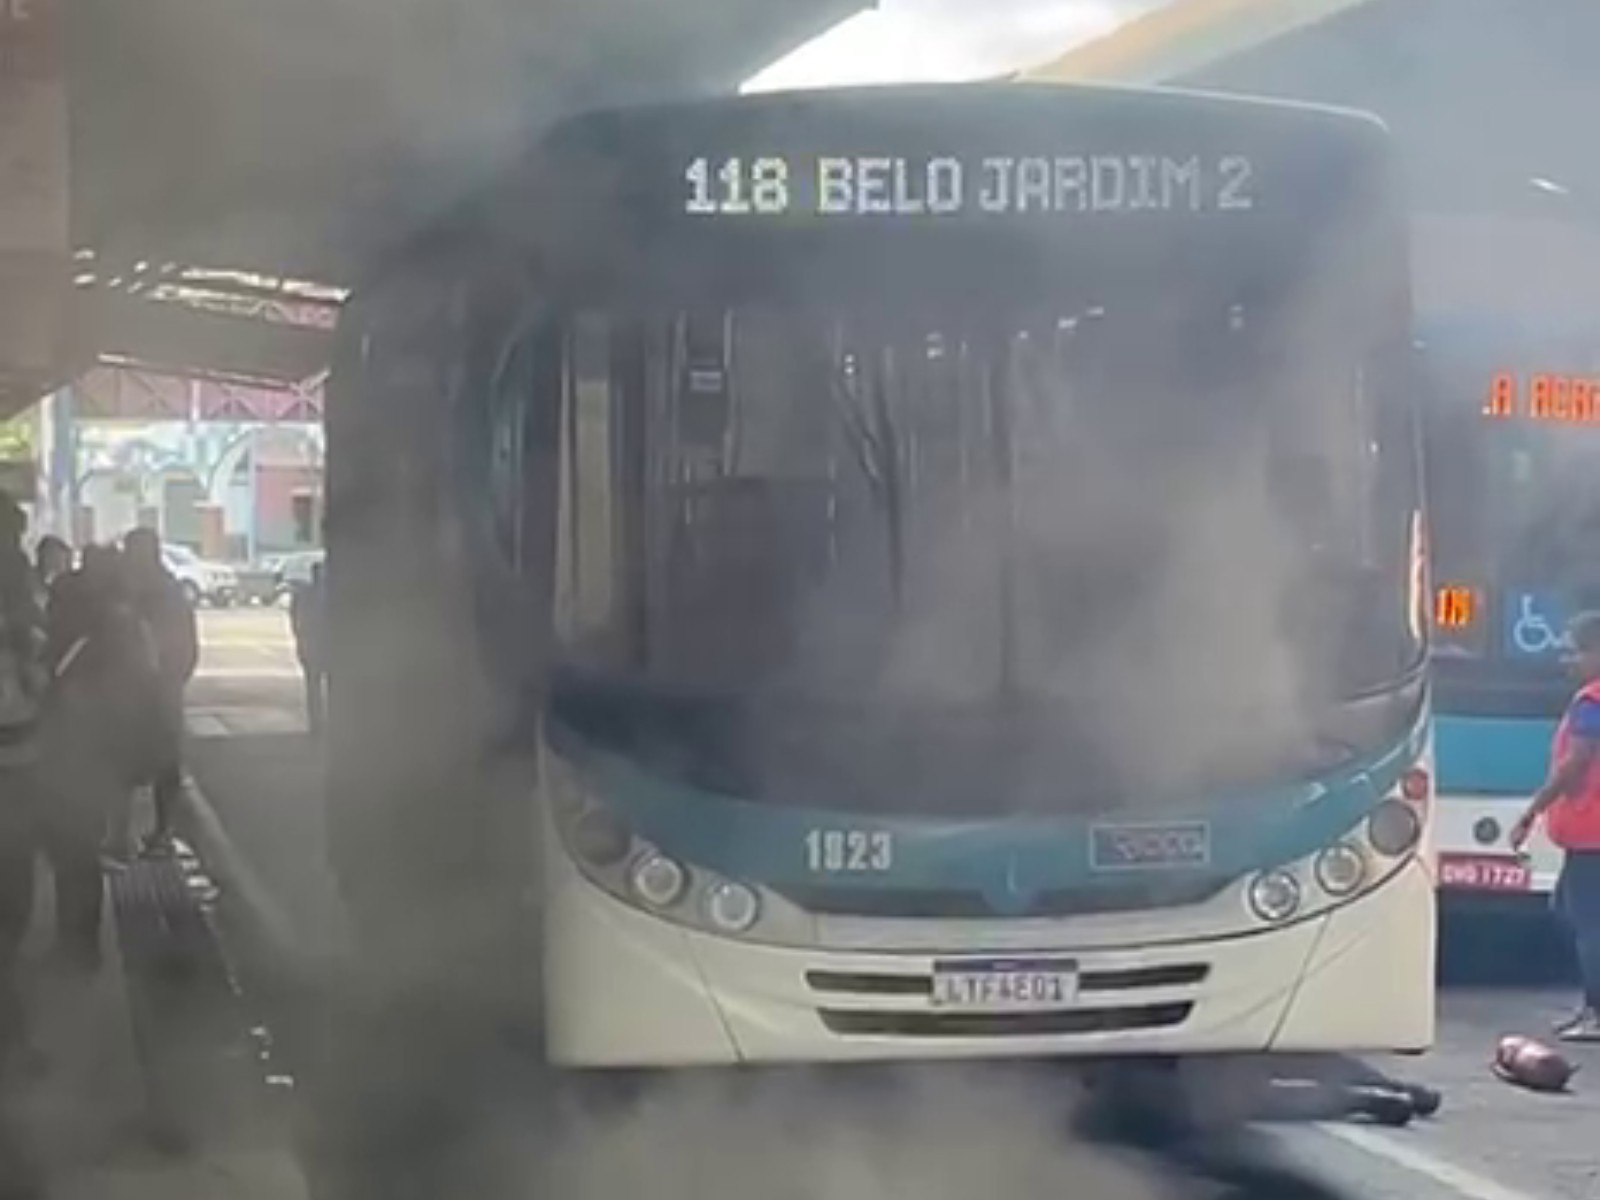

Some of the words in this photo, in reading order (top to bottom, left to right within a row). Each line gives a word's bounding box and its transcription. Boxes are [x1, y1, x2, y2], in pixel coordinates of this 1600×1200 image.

[684, 157, 788, 214] 118
[818, 157, 963, 213] BELO
[978, 156, 1199, 211] JARDIM
[1218, 155, 1254, 208] 2
[804, 830, 891, 870] 1023
